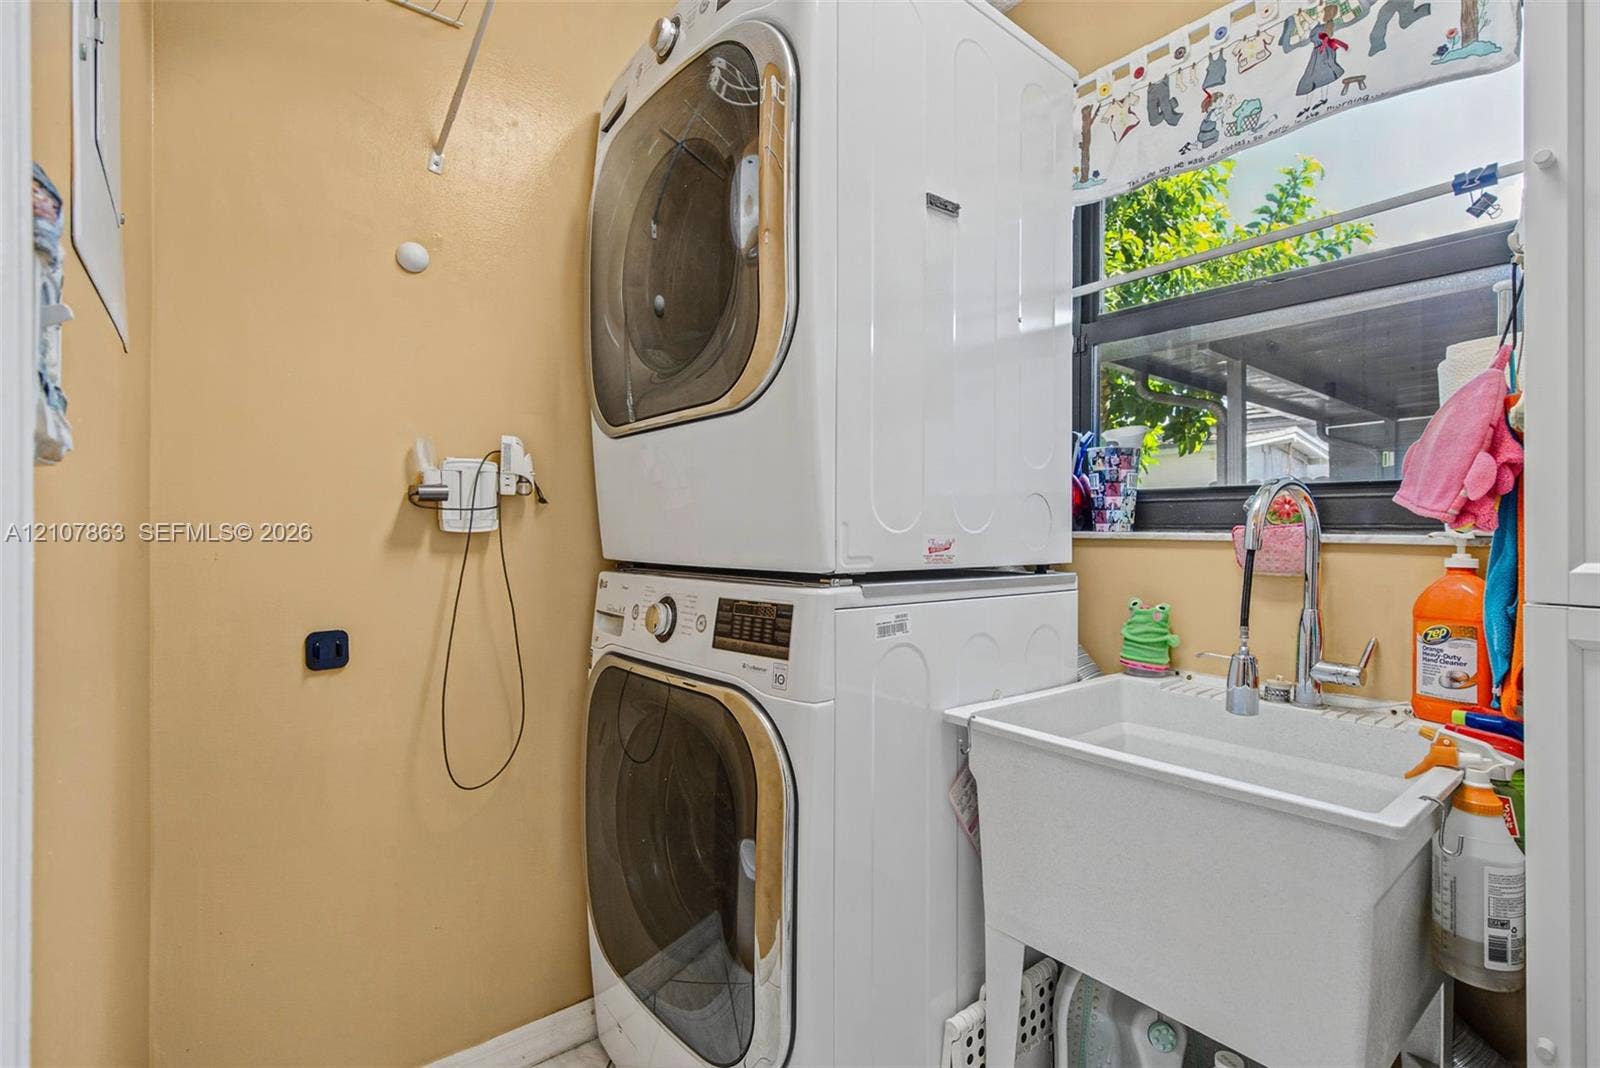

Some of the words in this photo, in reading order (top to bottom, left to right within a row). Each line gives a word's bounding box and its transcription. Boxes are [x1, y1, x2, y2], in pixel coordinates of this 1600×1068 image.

[1422, 645, 1444, 653] Orange
[1422, 651, 1462, 662] Heavy-Duty
[1438, 659, 1468, 667] Cleaner
